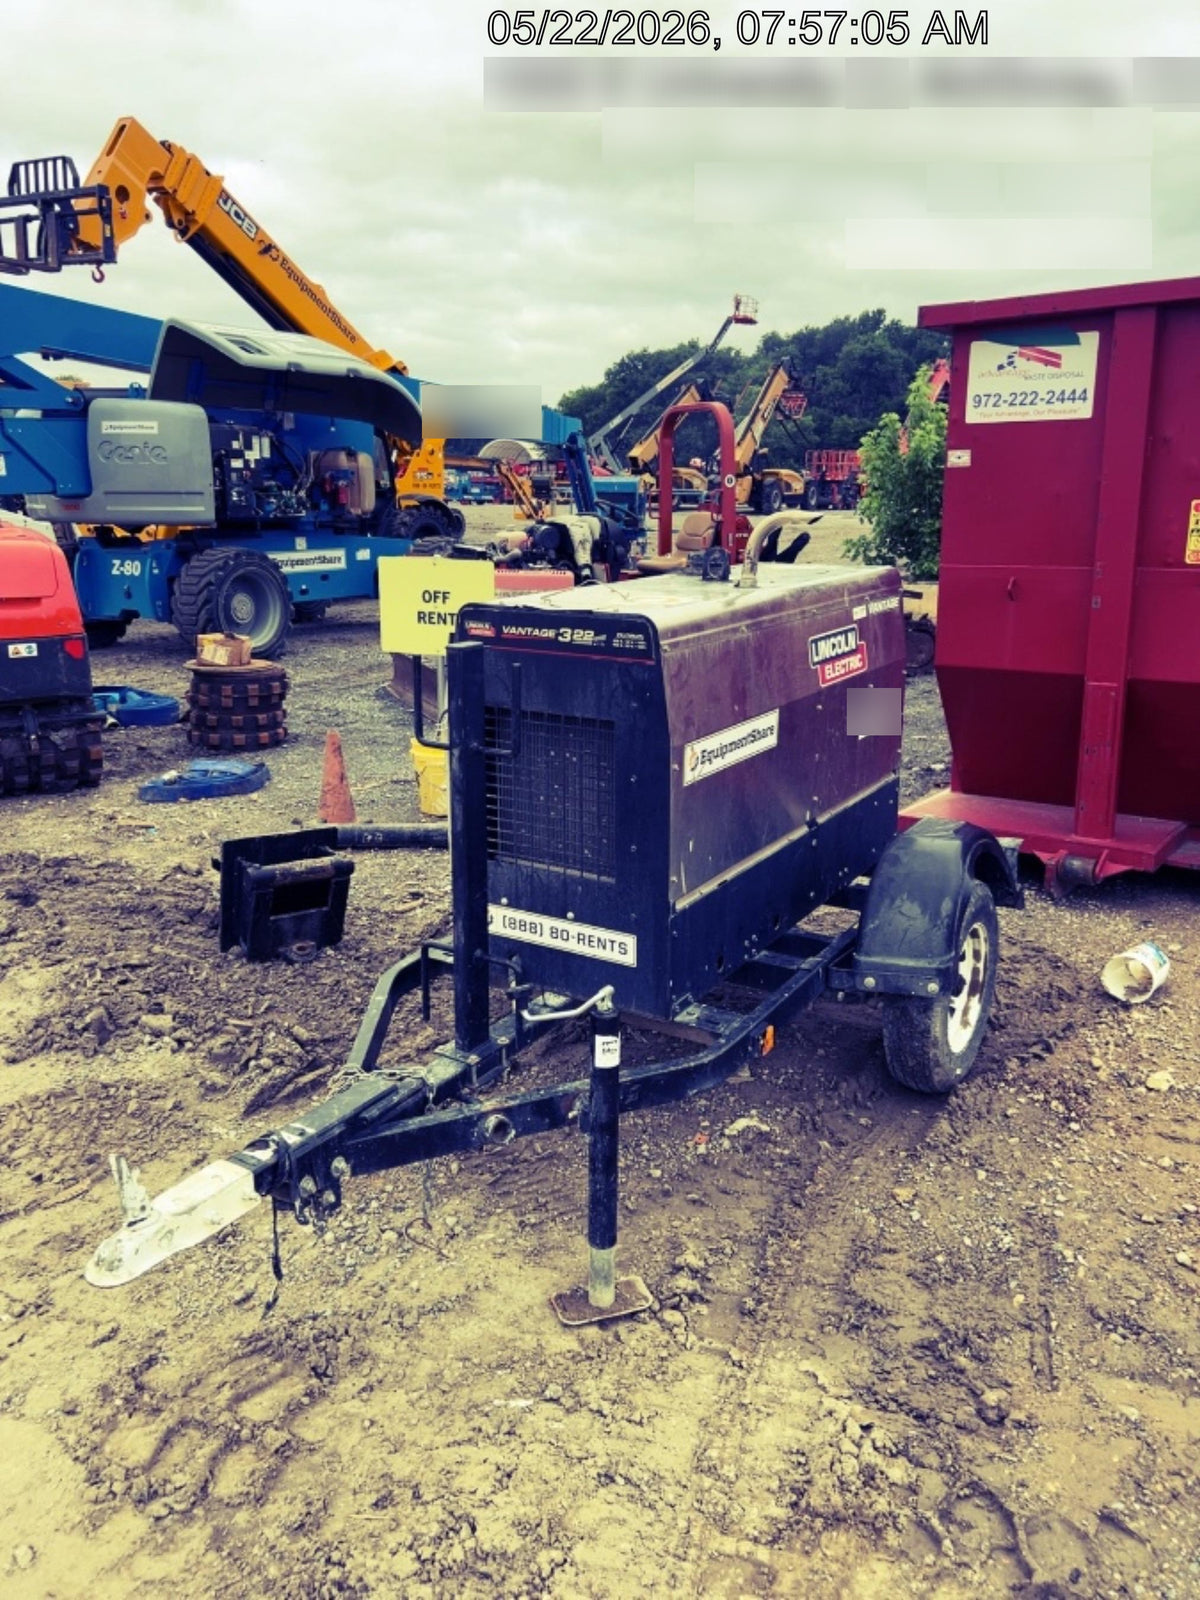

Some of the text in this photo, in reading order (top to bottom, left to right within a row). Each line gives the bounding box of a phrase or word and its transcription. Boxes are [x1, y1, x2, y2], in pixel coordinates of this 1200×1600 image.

[218, 197, 258, 240] JCB
[279, 256, 357, 344] EquipmentShare
[972, 387, 1088, 409] 972-222-2444
[97, 440, 168, 465] Genie
[111, 559, 142, 576] Z-80
[421, 589, 451, 604] OFF
[868, 597, 900, 614] VANTAGE
[416, 611, 456, 626] RENT
[502, 625, 556, 639] VANTAGE
[558, 627, 595, 643] 322
[812, 630, 856, 662] LINCOLN
[824, 654, 863, 680] ELECTRIC
[699, 724, 775, 766] EquipmentShare
[502, 914, 628, 955] (888) 80-RENTS
